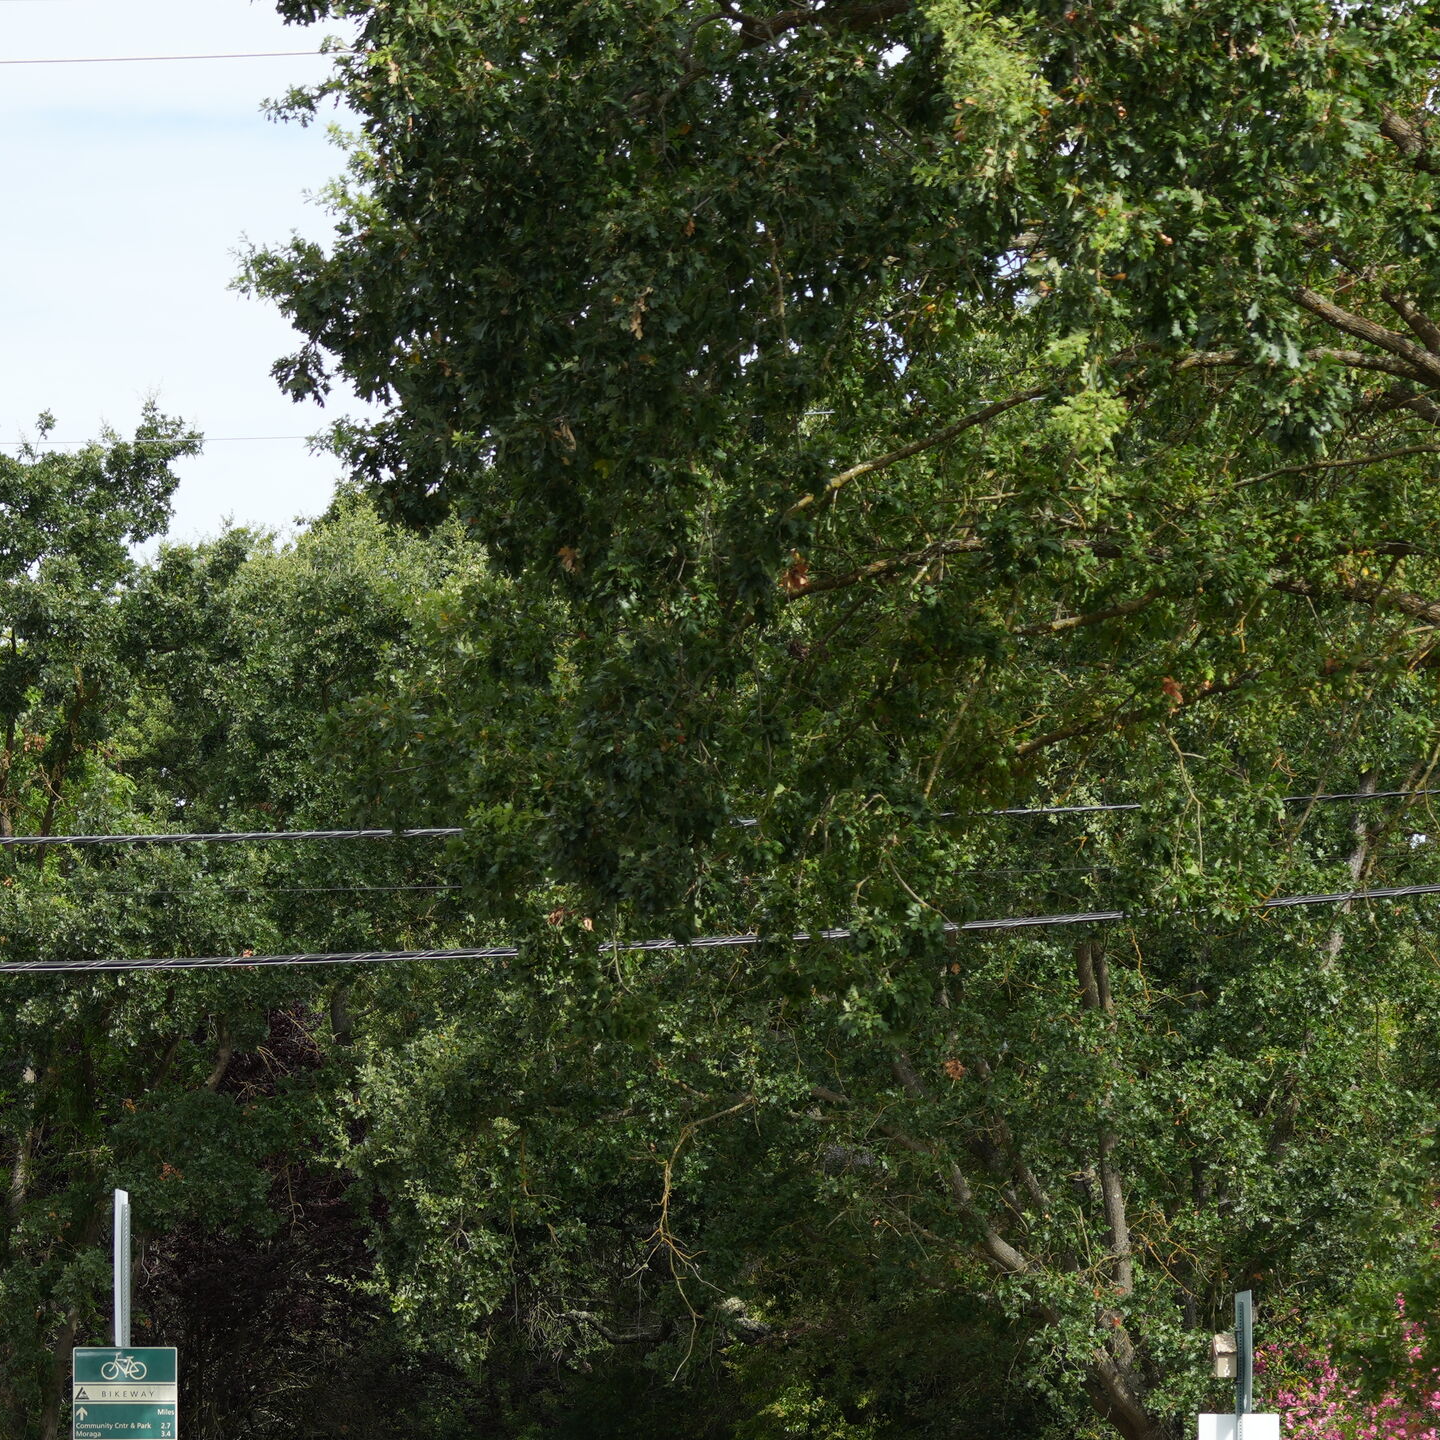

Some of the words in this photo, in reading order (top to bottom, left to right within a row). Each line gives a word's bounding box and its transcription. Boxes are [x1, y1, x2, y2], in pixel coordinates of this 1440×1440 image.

[101, 1390, 155, 1398] BIKEWAY
[157, 1408, 175, 1416] Miles
[76, 1422, 113, 1430] Community
[76, 1430, 101, 1438] Moraga
